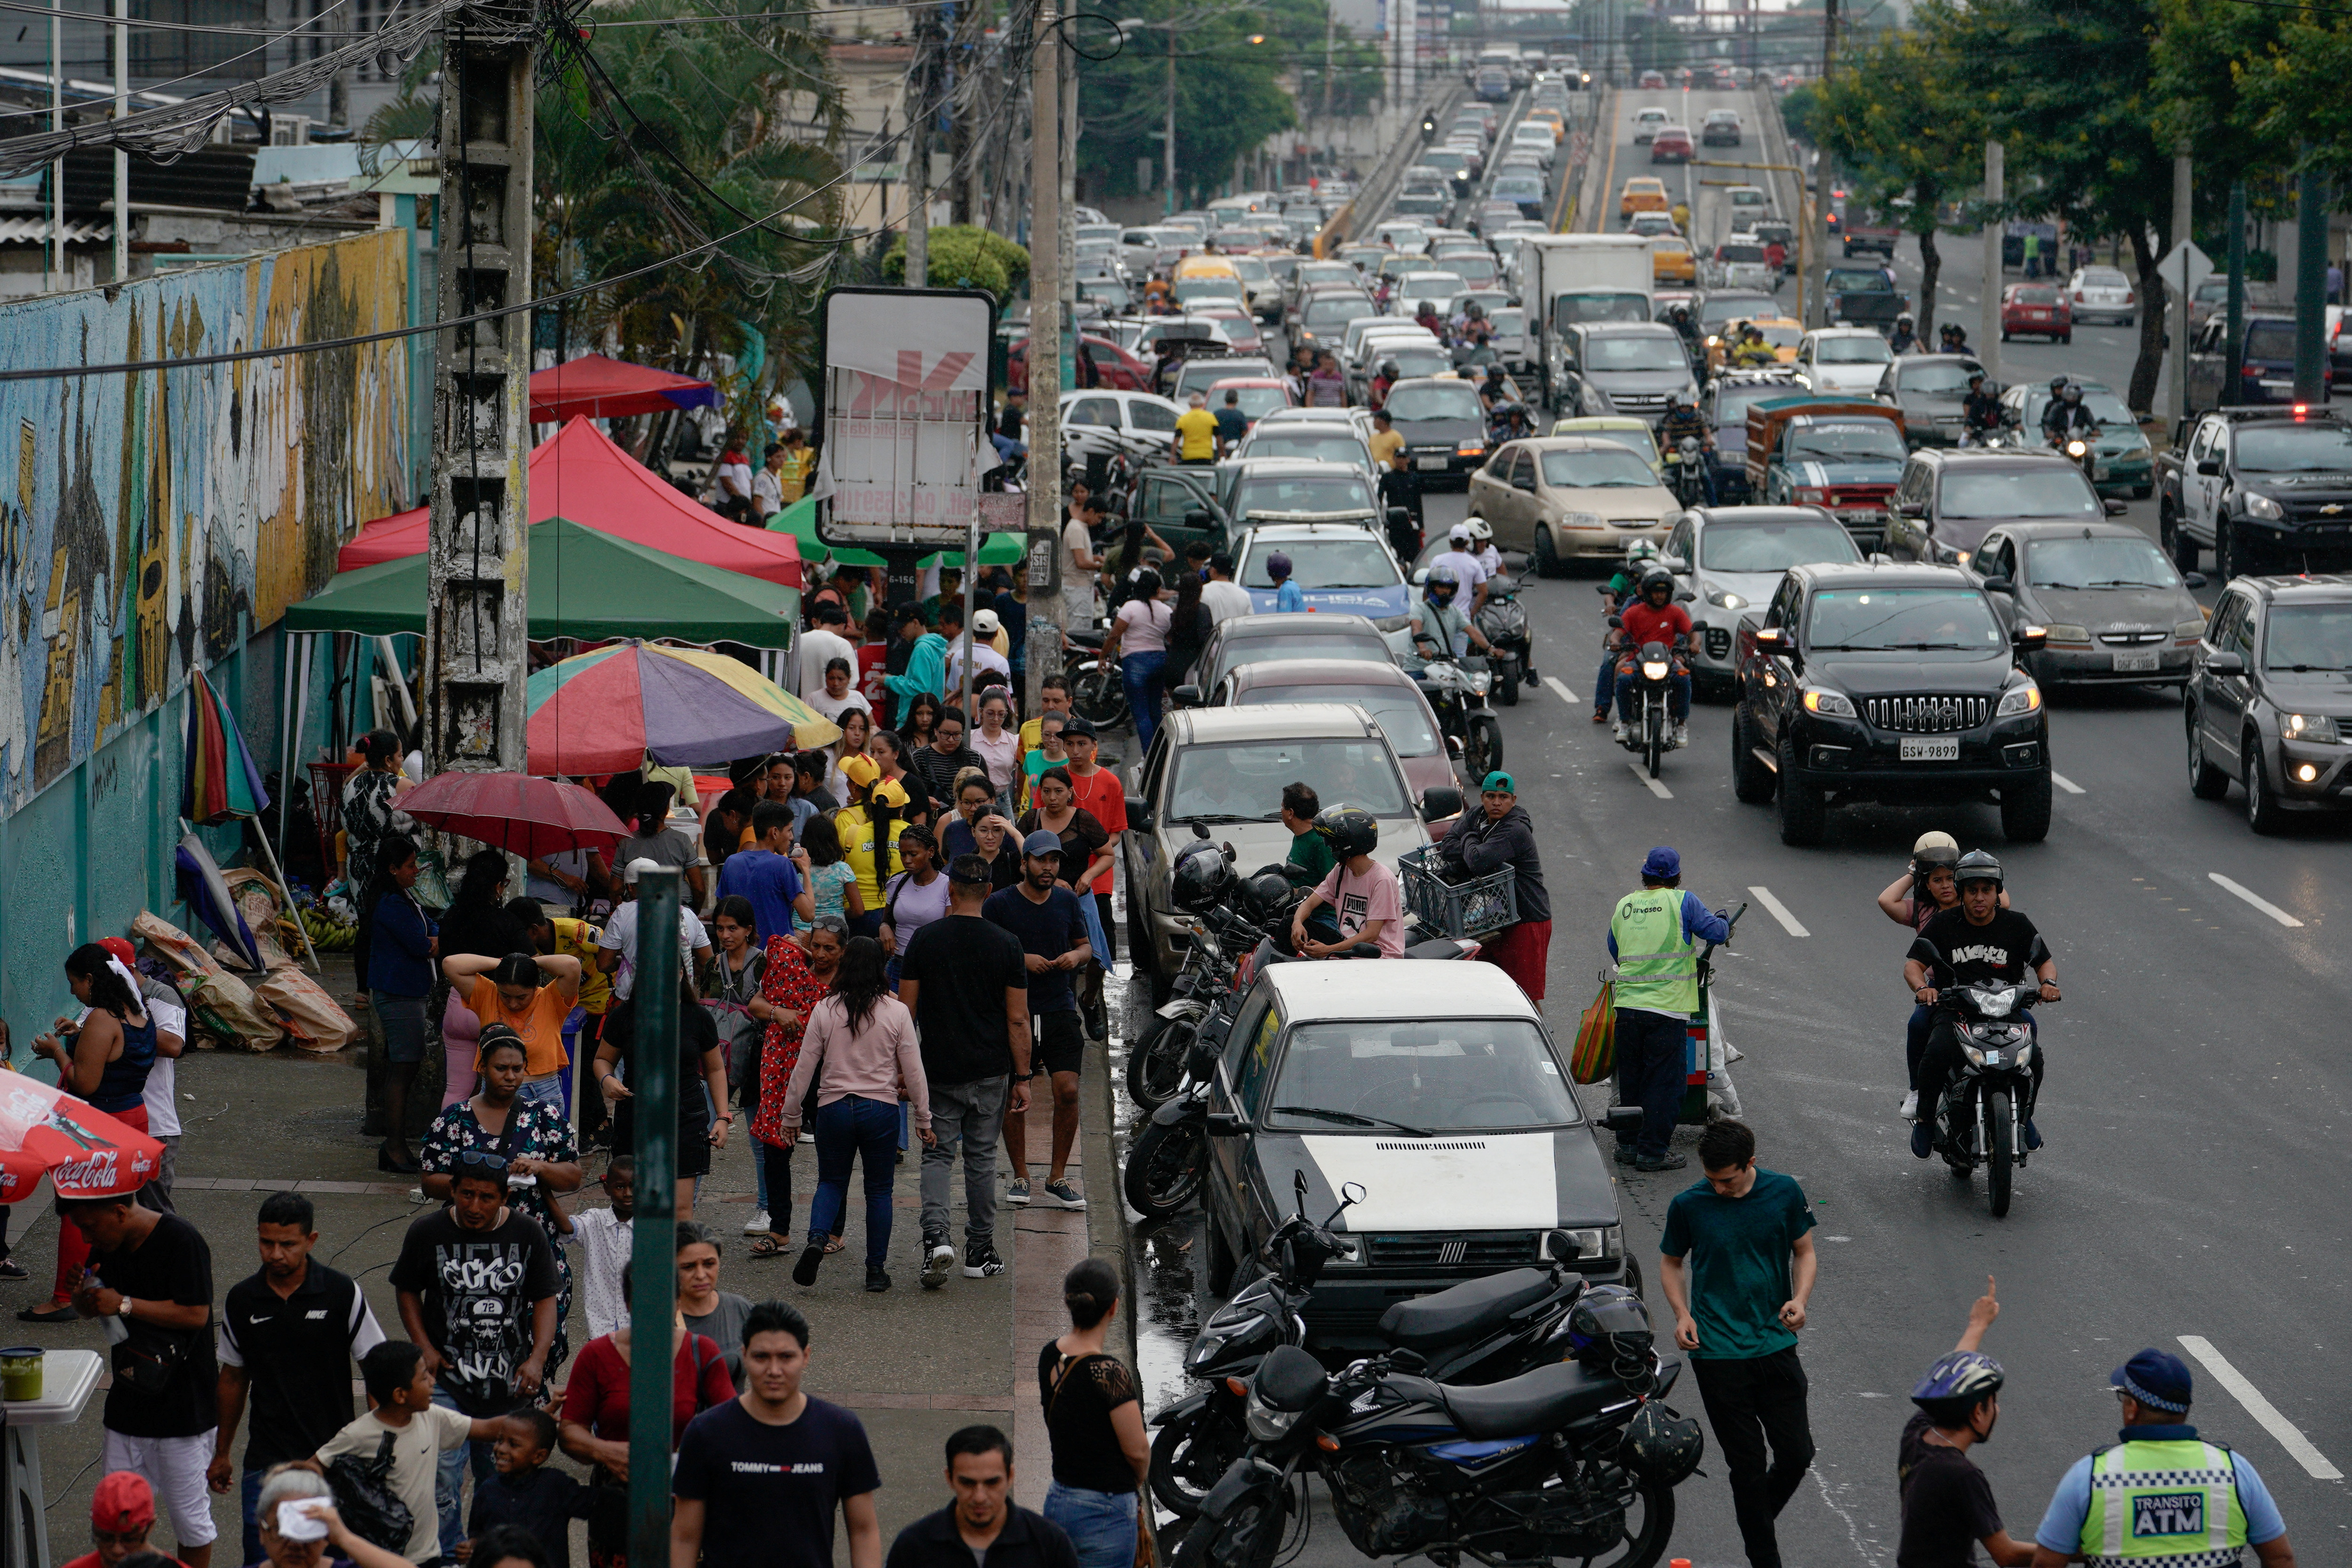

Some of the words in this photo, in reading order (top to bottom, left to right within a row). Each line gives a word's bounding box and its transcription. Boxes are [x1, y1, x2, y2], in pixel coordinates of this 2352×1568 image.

[1901, 705, 1957, 720] JAC
[1902, 746, 1956, 757] GSW-9899
[1346, 897, 1366, 913] PUMA
[1952, 944, 2008, 964] MICKEY
[53, 1151, 118, 1189] Coca-Cola
[304, 1309, 328, 1320] NIKE
[483, 1303, 495, 1312] 72
[1261, 1394, 1279, 1407] HONDA
[1352, 1404, 1382, 1414] HONDA
[731, 1461, 770, 1473] TOMMY
[791, 1462, 824, 1473] JEANS
[2134, 1495, 2201, 1511] TRANSITO
[2134, 1507, 2201, 1535] ATM
